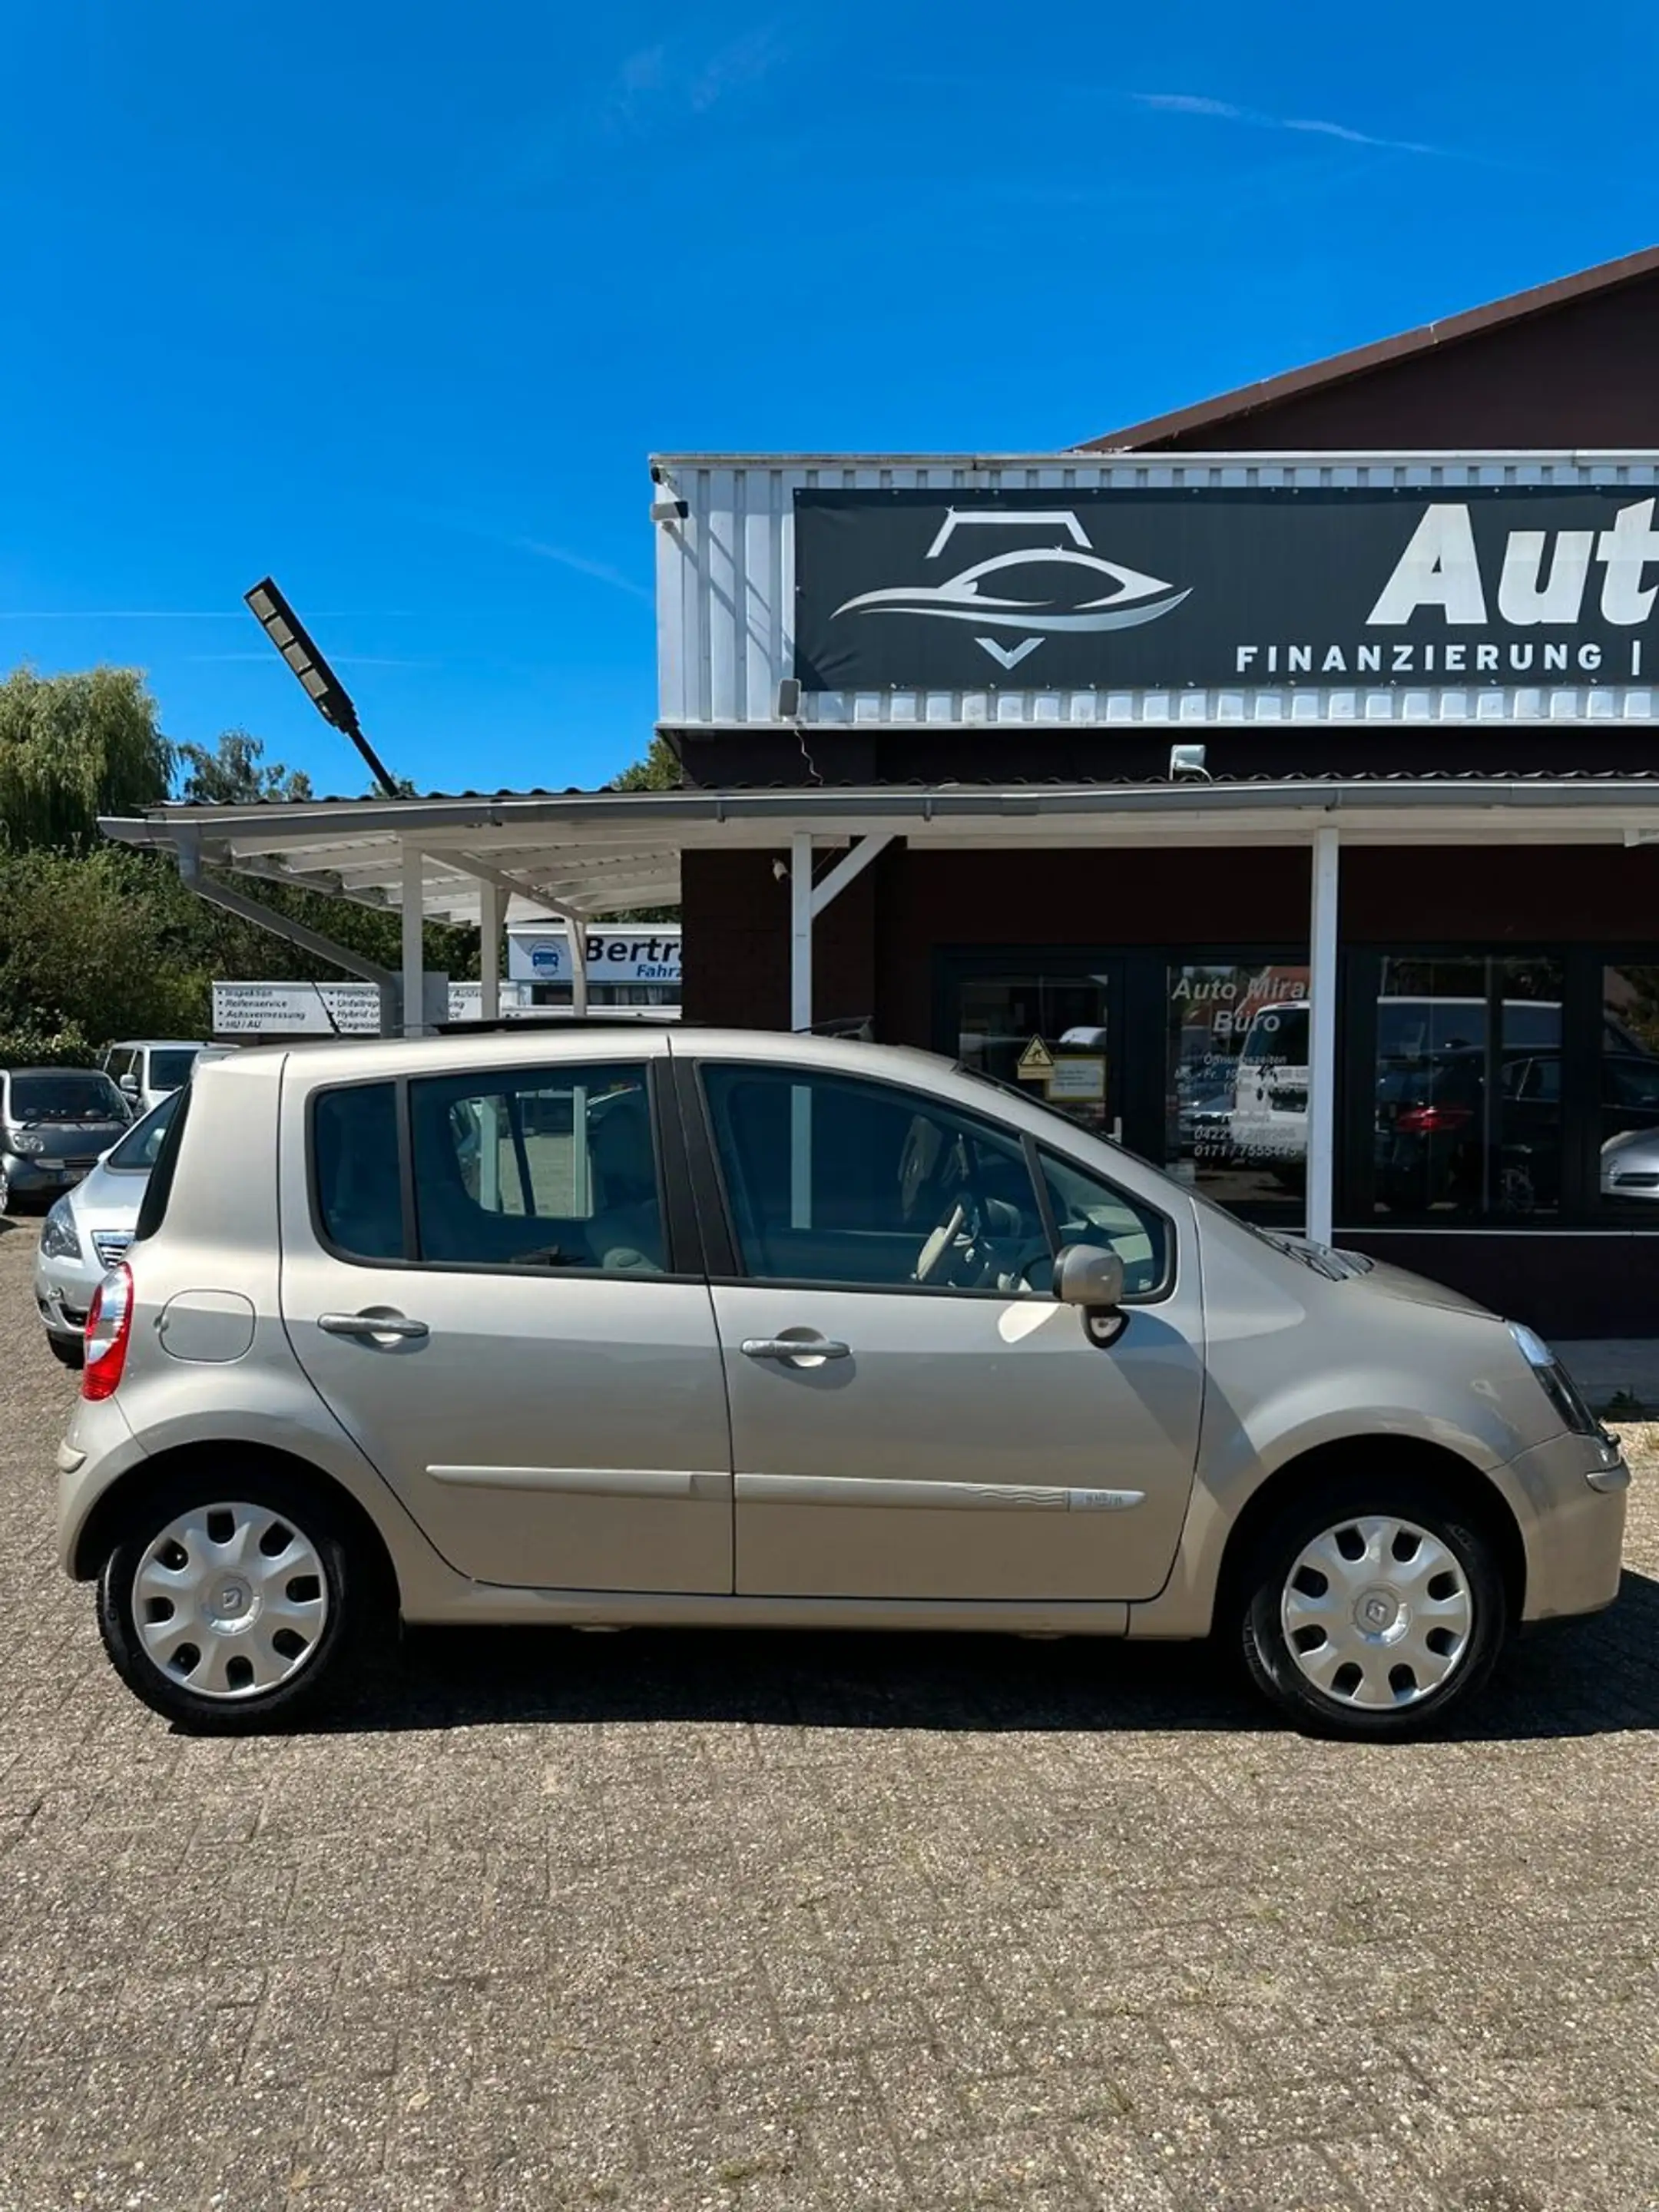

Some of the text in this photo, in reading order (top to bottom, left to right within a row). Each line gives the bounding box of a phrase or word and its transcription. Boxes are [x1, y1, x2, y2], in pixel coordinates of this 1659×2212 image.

[1365, 497, 1659, 626] Aut
[1236, 644, 1602, 673] FINANZIERUNG
[1171, 977, 1237, 1000] Auto
[1213, 1009, 1280, 1033] Büro
